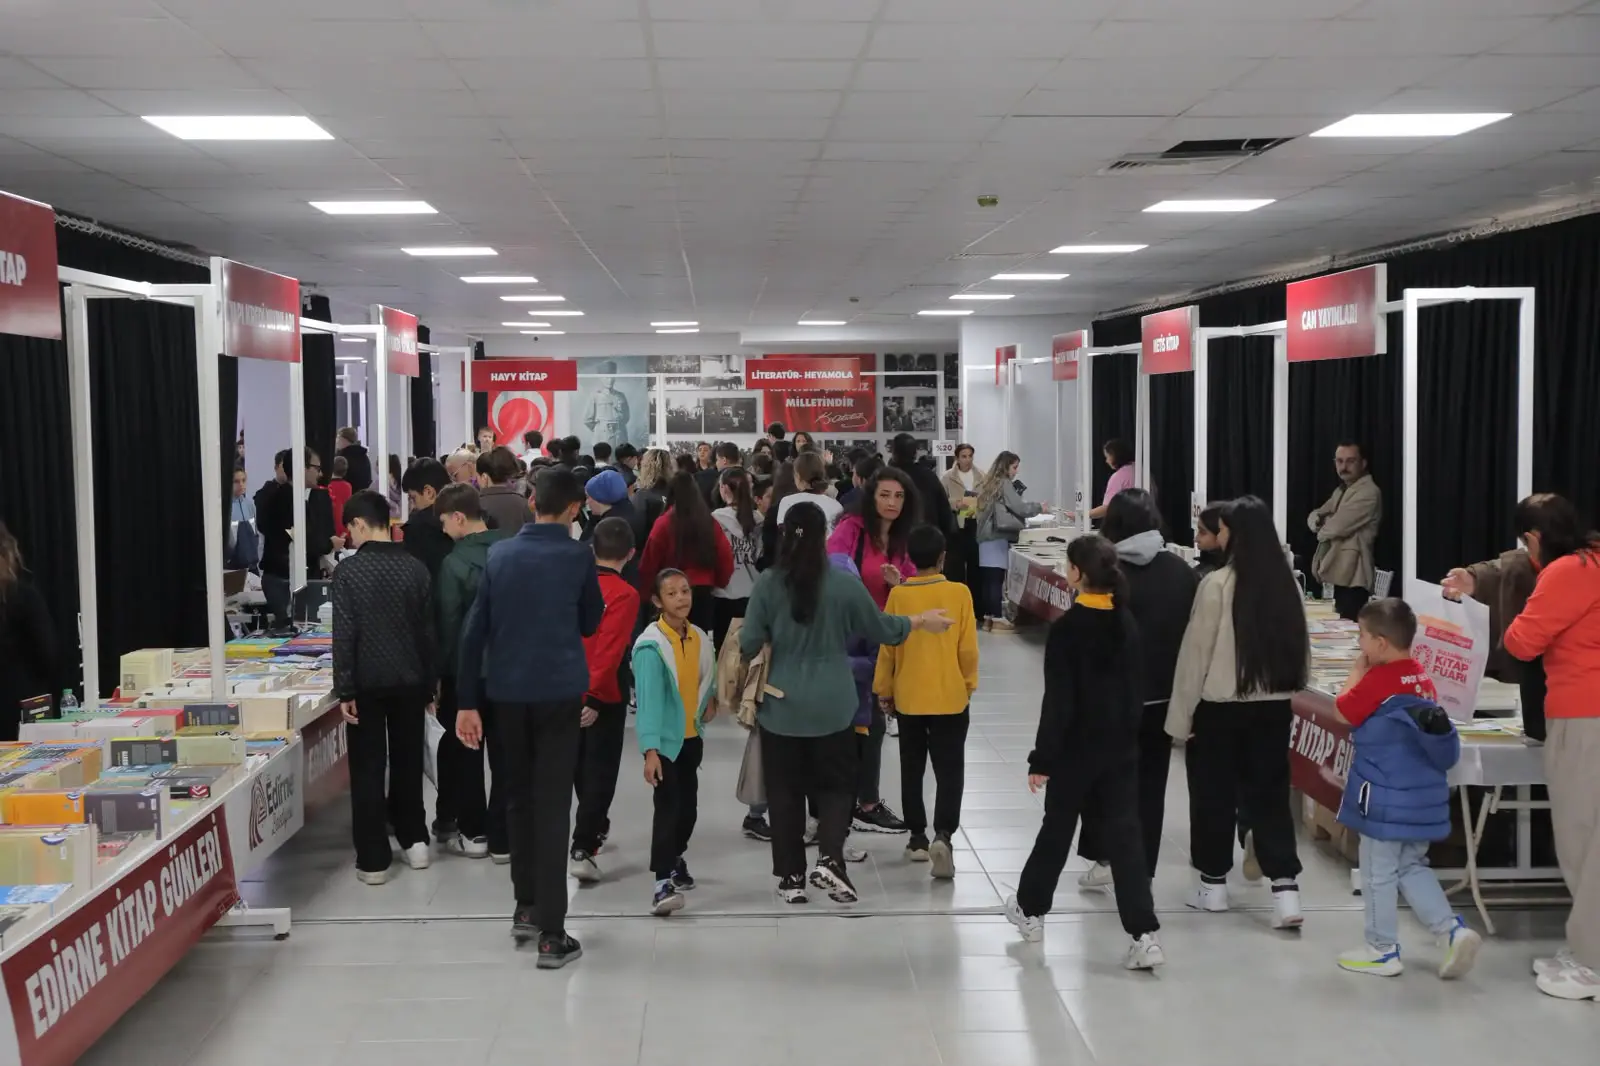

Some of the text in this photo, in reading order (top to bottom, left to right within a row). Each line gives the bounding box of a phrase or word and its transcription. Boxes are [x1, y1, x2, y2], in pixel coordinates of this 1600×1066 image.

[490, 370, 548, 381] HAYY KİTAP
[804, 371, 853, 379] HEYAMOLA
[785, 395, 854, 408] MİLLETİNDİR
[1435, 655, 1469, 672] KİTAP
[1432, 665, 1468, 683] FUARI
[1296, 713, 1335, 766] KİTAP
[25, 813, 224, 1040] EDİRNE KİTAP GÜNLERİ
